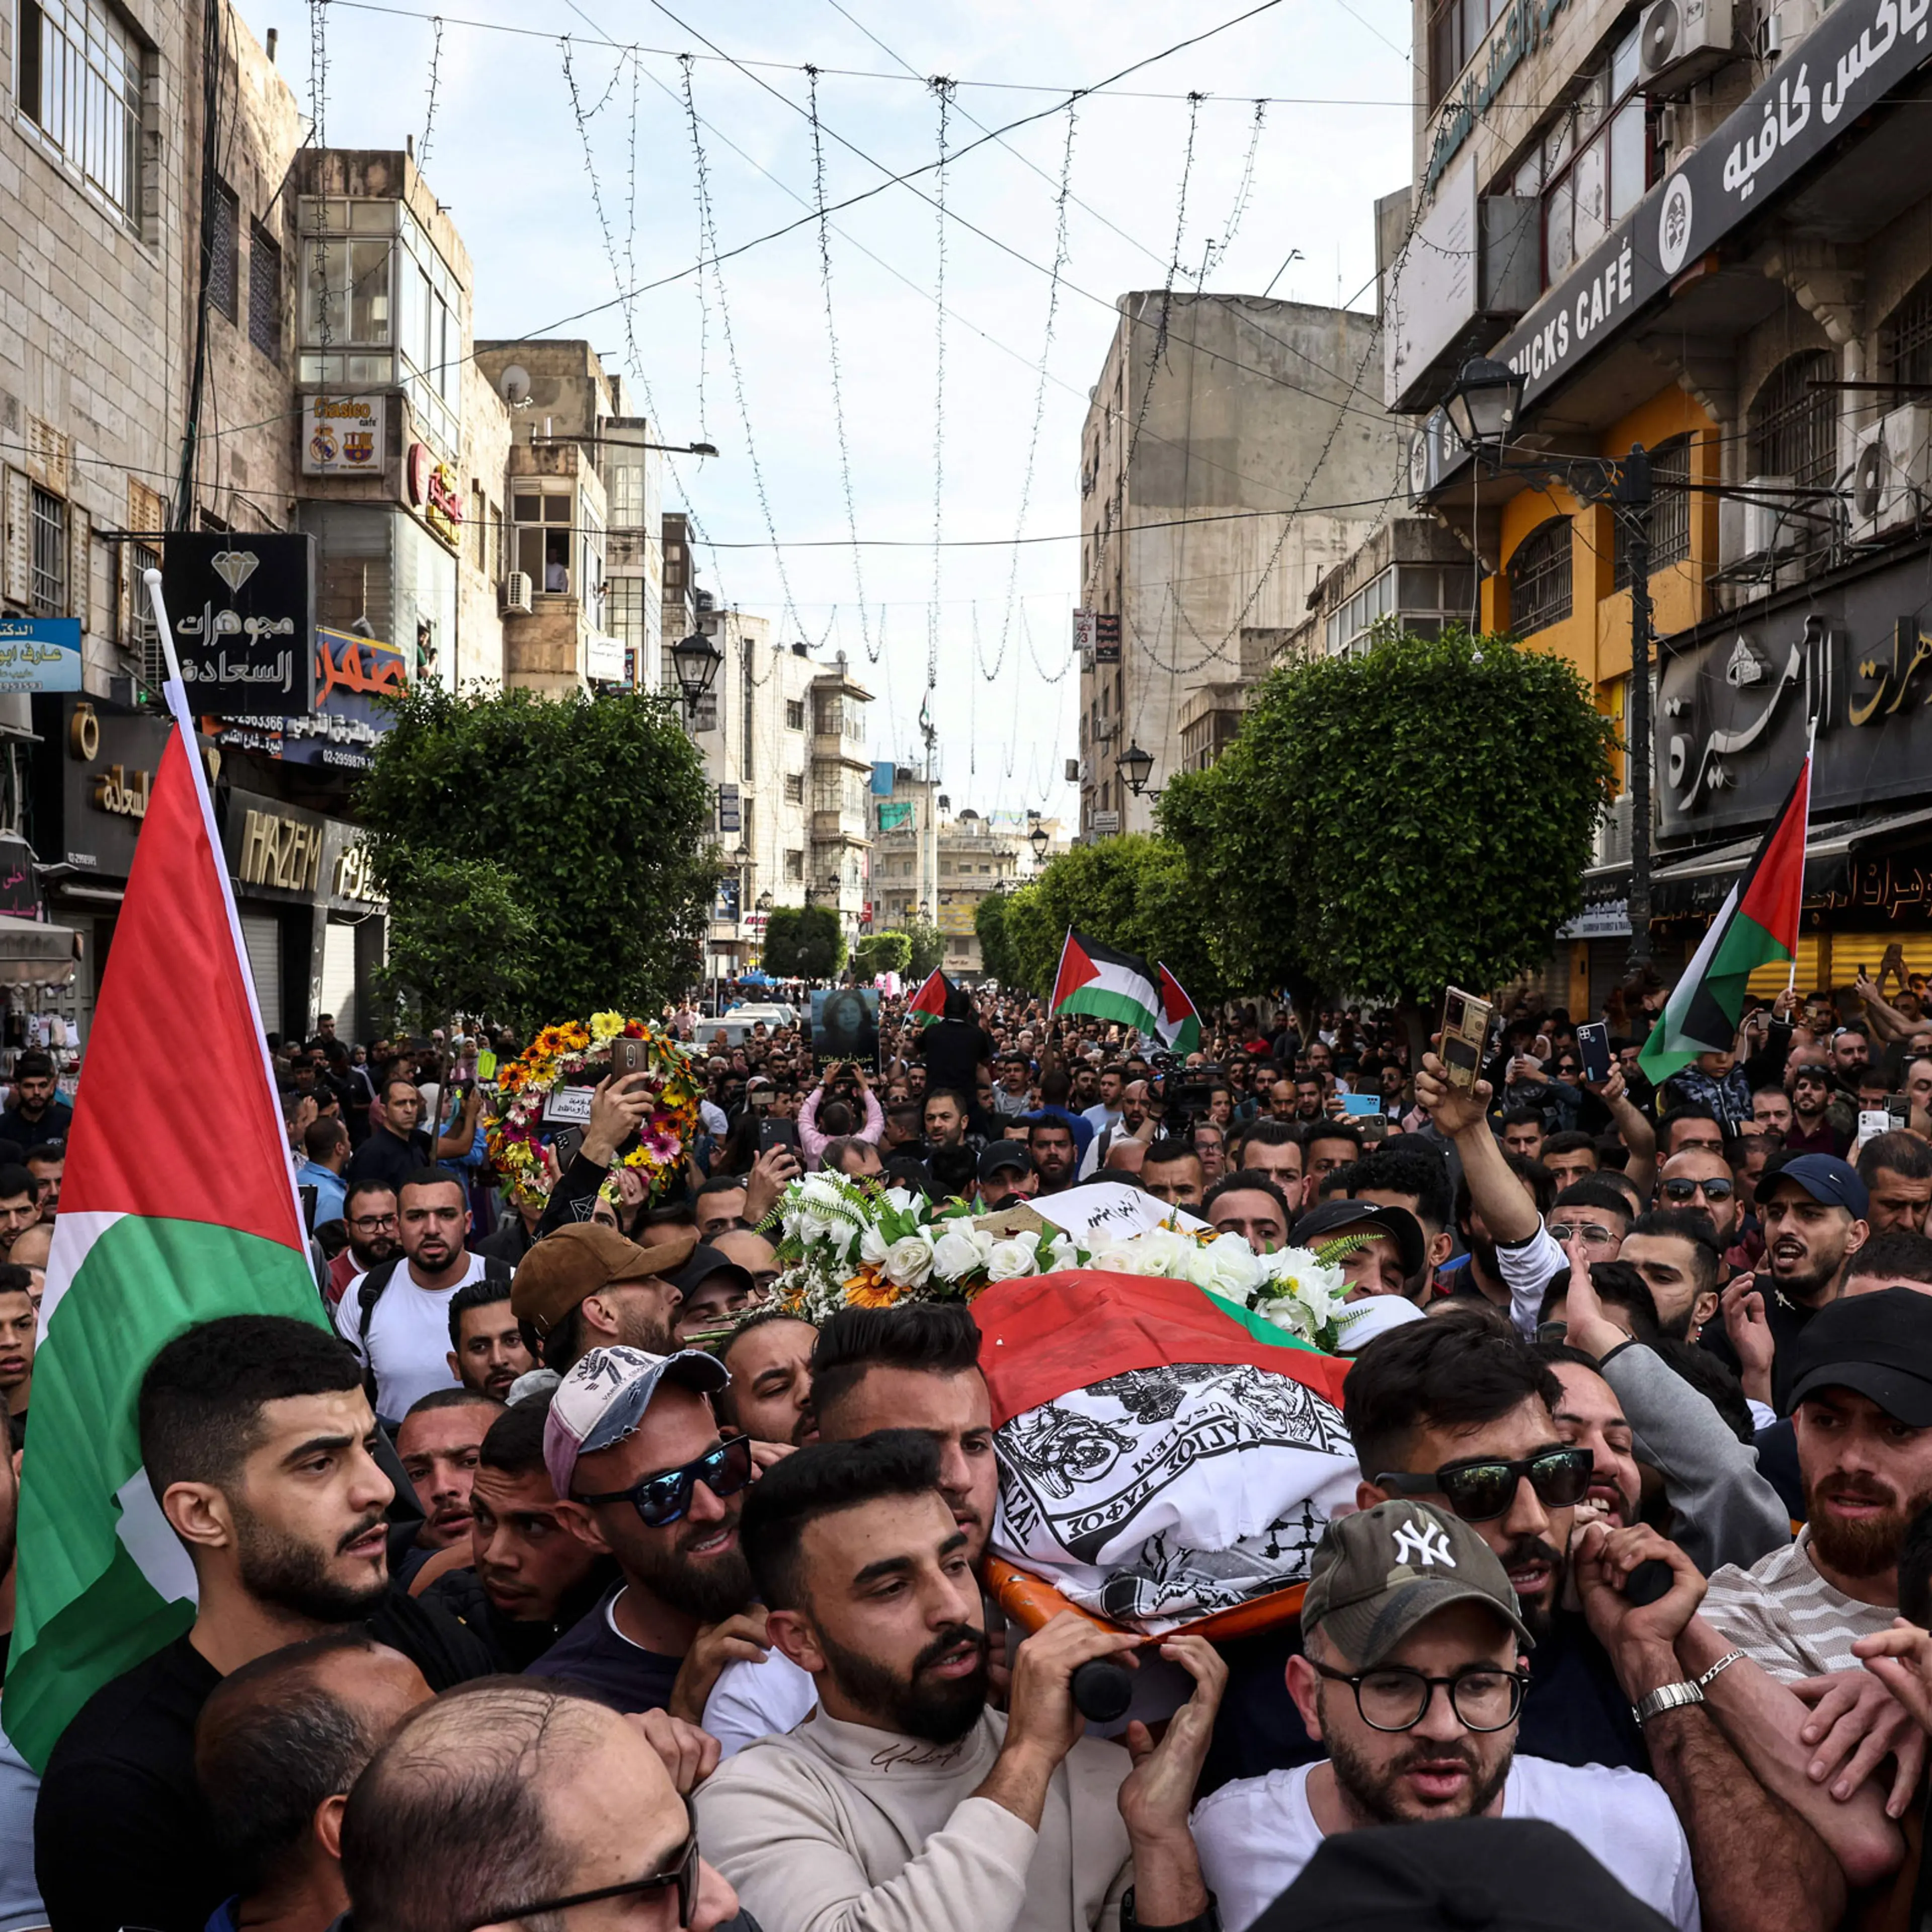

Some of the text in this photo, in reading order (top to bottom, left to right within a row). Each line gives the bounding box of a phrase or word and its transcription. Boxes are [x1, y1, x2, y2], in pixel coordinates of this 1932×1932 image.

[1723, 63, 1810, 201] كافيه
[1576, 236, 1632, 340] CAFÉ
[177, 600, 294, 646] مجوهرات
[182, 650, 292, 693] السعادة
[246, 809, 323, 892] HAZEM
[1392, 1519, 1457, 1568] NY
